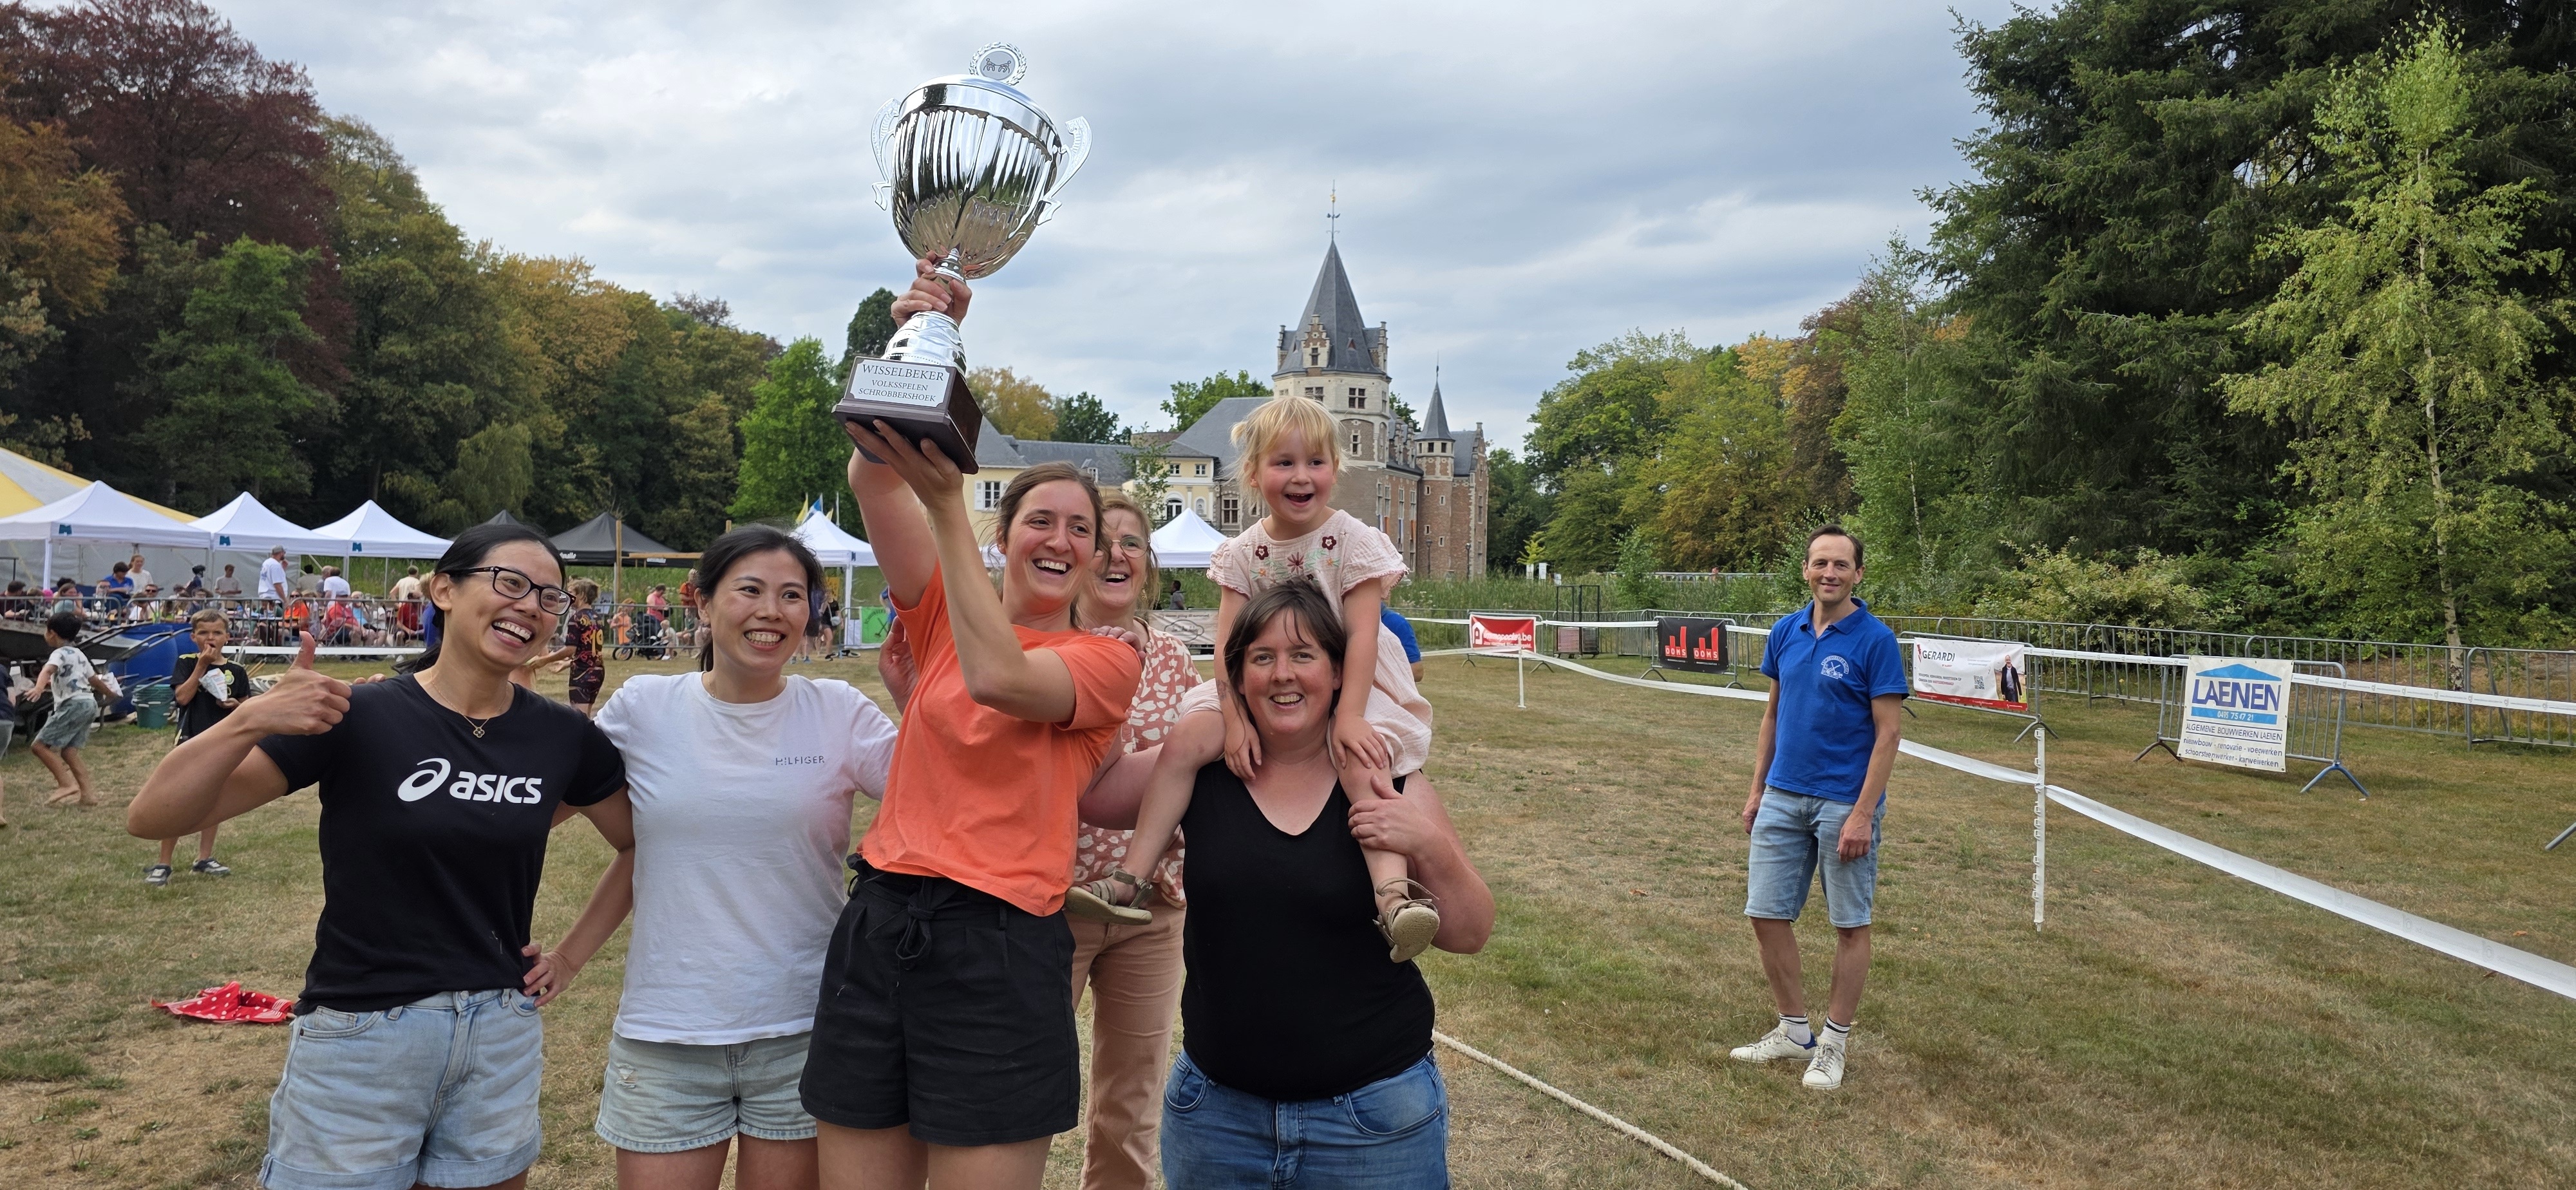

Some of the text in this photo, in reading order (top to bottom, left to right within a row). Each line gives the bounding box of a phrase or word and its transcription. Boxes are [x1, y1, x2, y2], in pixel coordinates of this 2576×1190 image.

[862, 364, 943, 381] WISSELBEKER
[871, 379, 928, 391] VOLKSSPELEN
[858, 388, 936, 402] SCHROBBERSHOEK
[1922, 650, 1955, 662] GERARDI
[2192, 679, 2281, 712] LAENEN
[2186, 722, 2282, 741] ALGEMENE BOUWWERKEN LAENEN
[2183, 737, 2213, 747] nieuwbouw
[2217, 743, 2242, 751] renovatie
[775, 755, 825, 766] HILFIGER
[449, 771, 542, 804] asics
